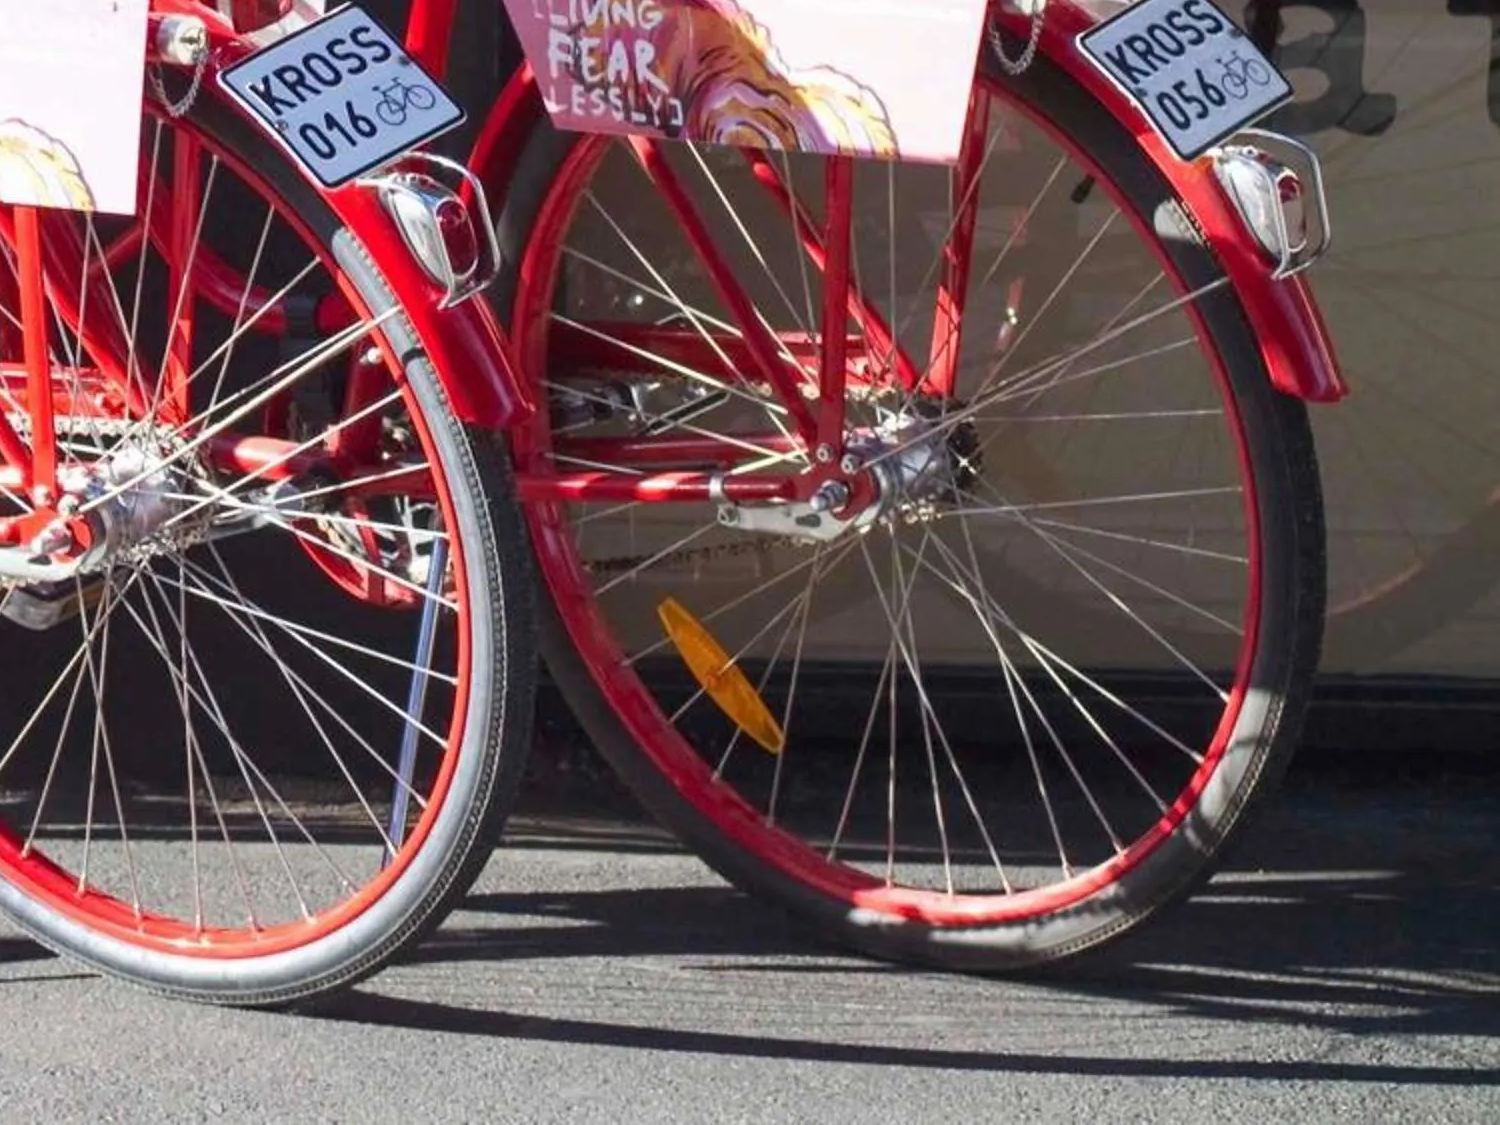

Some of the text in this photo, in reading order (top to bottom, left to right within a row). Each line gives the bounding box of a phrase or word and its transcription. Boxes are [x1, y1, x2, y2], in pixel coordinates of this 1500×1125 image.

[249, 26, 392, 116] KROSS
[547, 27, 670, 93] FEAR
[1104, 0, 1224, 85] KROSS
[298, 101, 378, 160] 016
[1156, 68, 1227, 131] 056
